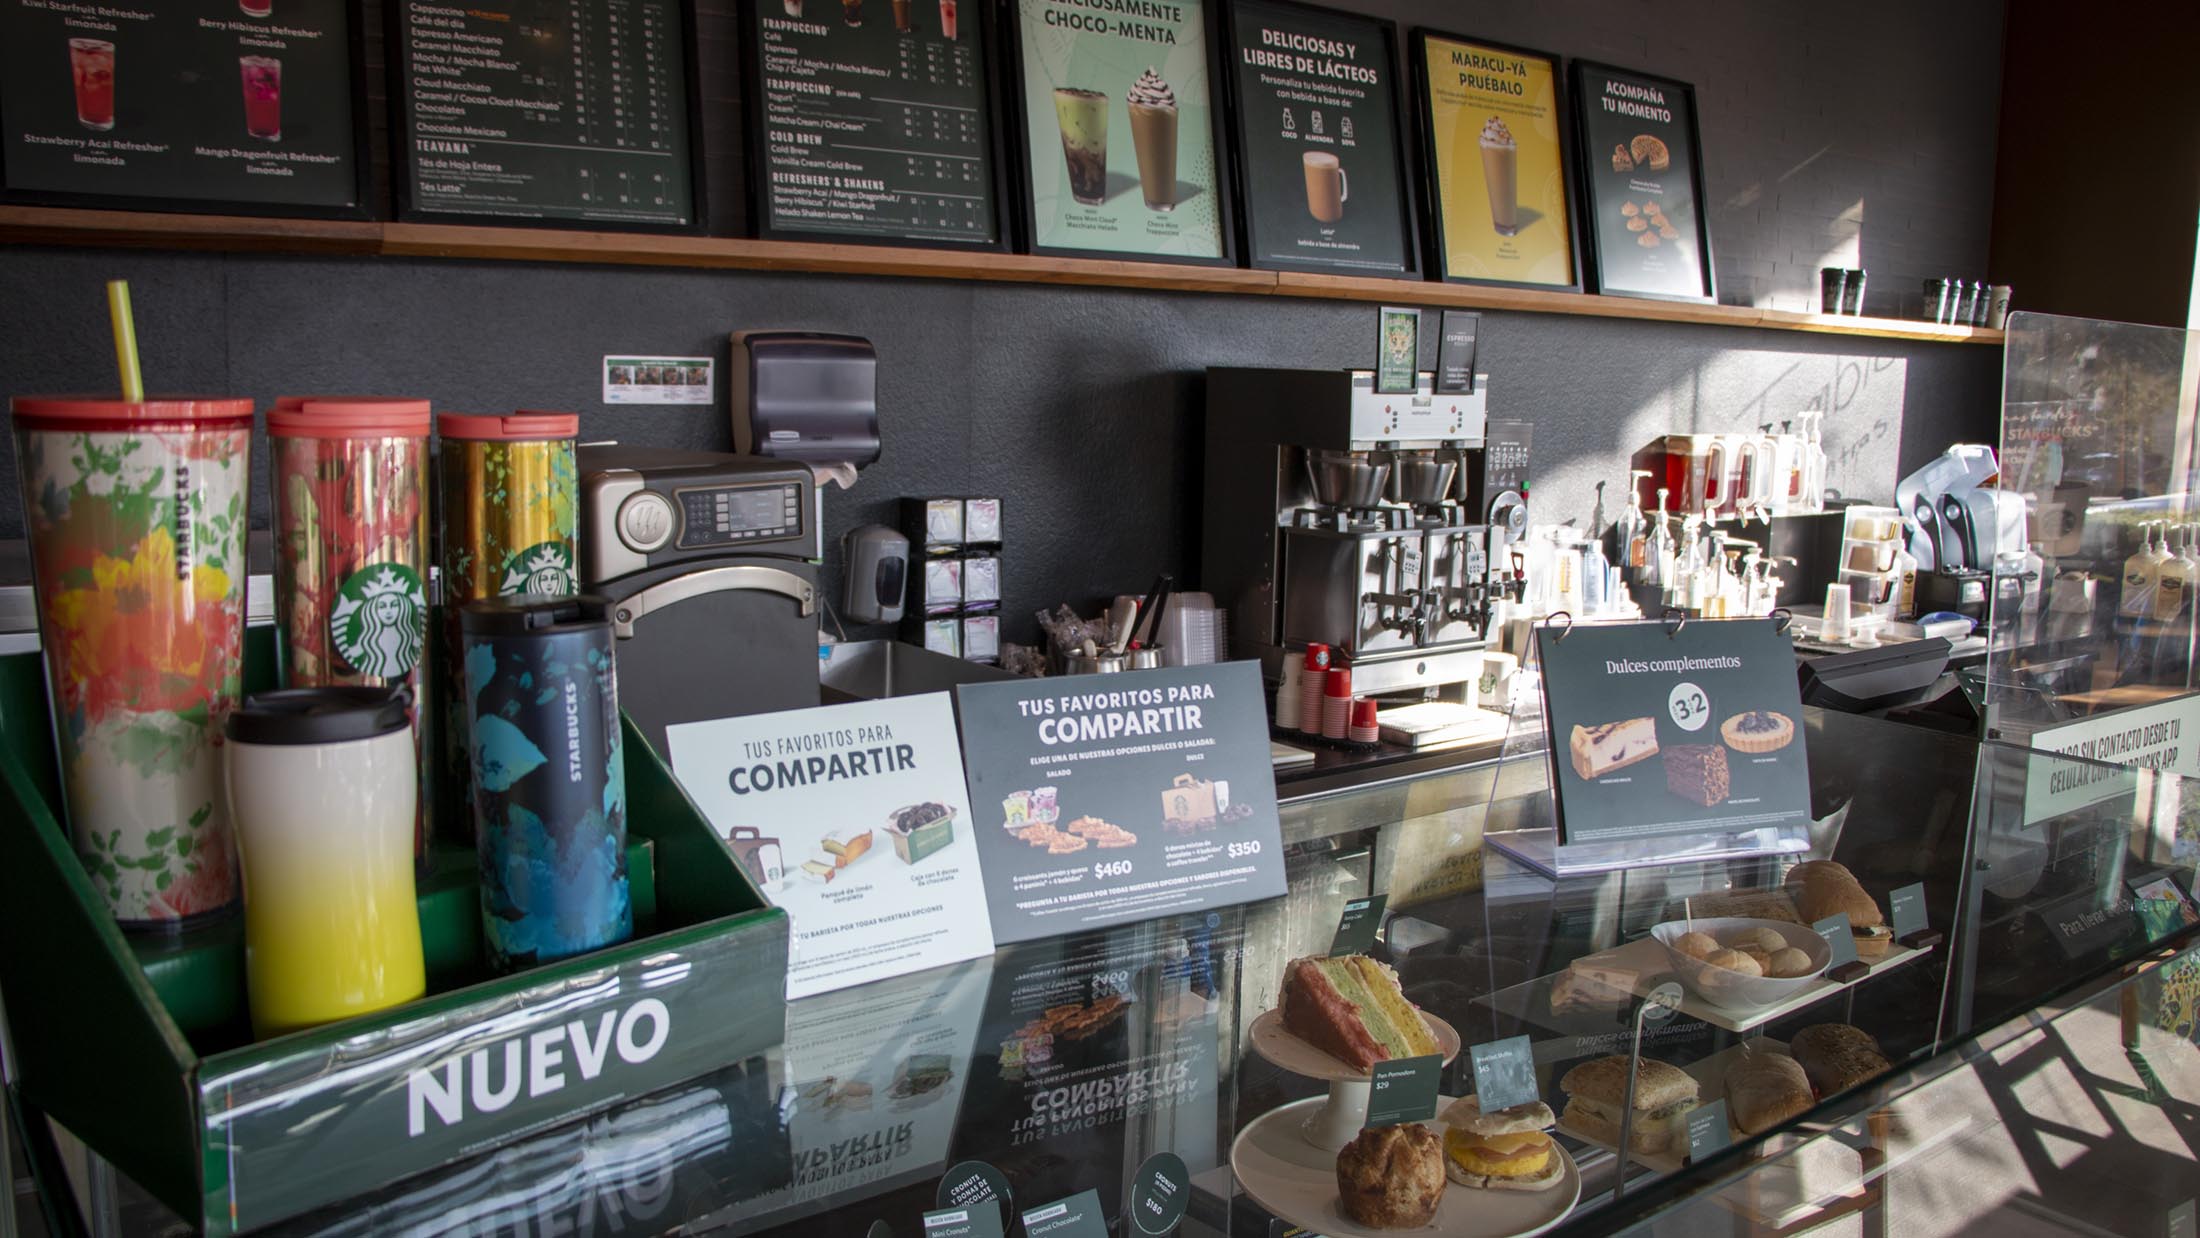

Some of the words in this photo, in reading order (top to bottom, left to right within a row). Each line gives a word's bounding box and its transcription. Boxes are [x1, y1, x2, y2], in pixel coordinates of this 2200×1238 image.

[49, 2, 96, 15] Starfruit
[409, 2, 466, 17] Cappuccino
[64, 17, 117, 31] limonada
[200, 18, 226, 31] Berry
[229, 21, 270, 34] Hibiscus
[434, 17, 449, 26] del
[1045, 9, 1176, 45] CHOCO-MENTA
[239, 36, 286, 49] limonada
[411, 26, 452, 40] Espresso
[453, 31, 503, 45] Americano
[1262, 28, 1345, 59] DELICIOSAS
[1346, 44, 1356, 60] Y
[411, 39, 451, 51] Caramel
[452, 44, 501, 57] Macchiato
[765, 43, 798, 56] Espresso
[412, 51, 445, 63] Mocha
[453, 56, 485, 68] Mocha
[413, 63, 431, 74] Flat
[1243, 47, 1293, 72] LIBRES
[1296, 57, 1315, 75] DE
[1317, 58, 1377, 85] LÁCTEOS
[1452, 51, 1527, 77] MARACU-YÁ
[413, 76, 442, 89] Cloud
[443, 80, 492, 94] Macchiato
[1260, 73, 1303, 89] Personaliza
[1312, 81, 1337, 95] bebida
[1337, 84, 1366, 99] favorita
[1459, 73, 1523, 96] PRUÉBALO
[1606, 79, 1665, 105] ACOMPAÑA
[414, 89, 453, 102] Caramel
[488, 96, 514, 108] Cloud
[1276, 89, 1290, 99] con
[1291, 89, 1317, 104] bebida
[1317, 96, 1322, 104] a
[1323, 96, 1340, 107] base
[415, 102, 466, 116] Chocolates
[1601, 96, 1617, 112] TU
[1617, 99, 1672, 123] MOMENTO
[416, 121, 463, 135] Chocolate
[463, 125, 508, 138] Mexicano
[769, 130, 794, 143] COLD
[796, 132, 823, 145] BREW
[1281, 130, 1298, 139] COCO
[1305, 133, 1335, 144] ALMENDRA
[24, 133, 85, 149] Strawberry
[1341, 138, 1356, 147] SOYA
[73, 153, 125, 166] limonada
[195, 146, 230, 158] Mango
[231, 148, 288, 162] Dragonfruit
[246, 164, 293, 177] limonada
[435, 159, 449, 169] de
[843, 177, 885, 191] SHAKENS
[175, 467, 191, 581] STARBUCKS
[1606, 659, 1649, 674] Dulces
[1650, 655, 1741, 674] complementos
[1018, 699, 1055, 717] TUS
[1060, 688, 1163, 713] FAVORITOS
[1167, 683, 1215, 703] PARA
[1675, 699, 1690, 720] 3
[1691, 693, 1707, 713] 2
[564, 680, 583, 784] STARBUCKS
[1038, 704, 1203, 745] COMPARTIR
[743, 739, 772, 760] TUS
[777, 728, 854, 755] FAVORITOS
[858, 724, 893, 744] PARA
[2081, 740, 2096, 760] SIN
[2098, 728, 2142, 759] CONTACTO
[2143, 721, 2169, 747] DESDE
[2170, 718, 2181, 740] TU
[1030, 756, 1051, 766] ELIGE
[1051, 754, 1068, 764] UNA
[1068, 752, 1079, 762] DE
[1079, 748, 1116, 760] NUESTRAS
[1116, 745, 1151, 756] OPCIONES
[1151, 742, 1177, 752] DULCES
[1178, 740, 1184, 749] O
[1184, 737, 1216, 748] SALADAS:
[1186, 753, 1205, 762] DULCE
[729, 743, 917, 796] COMPARTIR
[1046, 768, 1072, 778] SALADO
[2050, 765, 2089, 795] CELULAR
[2161, 746, 2178, 770] APP
[1228, 840, 1261, 859] $350
[1094, 860, 1132, 880] $460
[1059, 895, 1068, 903] TU
[1068, 891, 1094, 902] BARISTA
[1094, 889, 1108, 897] POR
[1108, 886, 1128, 896] TODAS
[1128, 881, 1159, 893] NUESTRAS
[1159, 877, 1189, 887] OPCIONES
[1194, 872, 1219, 881] SABORES
[800, 932, 810, 940] TU
[810, 926, 839, 939] BARISTA
[840, 923, 854, 932] POR
[855, 919, 878, 929] TODAS
[878, 912, 911, 924] NUESTRAS
[912, 904, 944, 917] OPCIONES
[2059, 920, 2084, 936] Para
[408, 998, 670, 1137] NUEVO
[1376, 1081, 1390, 1090] $29
[950, 1173, 980, 1196] CRONUTS
[1155, 1171, 1177, 1192] CRONUTS
[957, 1186, 979, 1203] DONAS
[978, 1179, 988, 1189] DE
[1145, 1197, 1163, 1215] $180
[931, 1230, 946, 1238] Mini
[1031, 1224, 1052, 1235] Cronut
